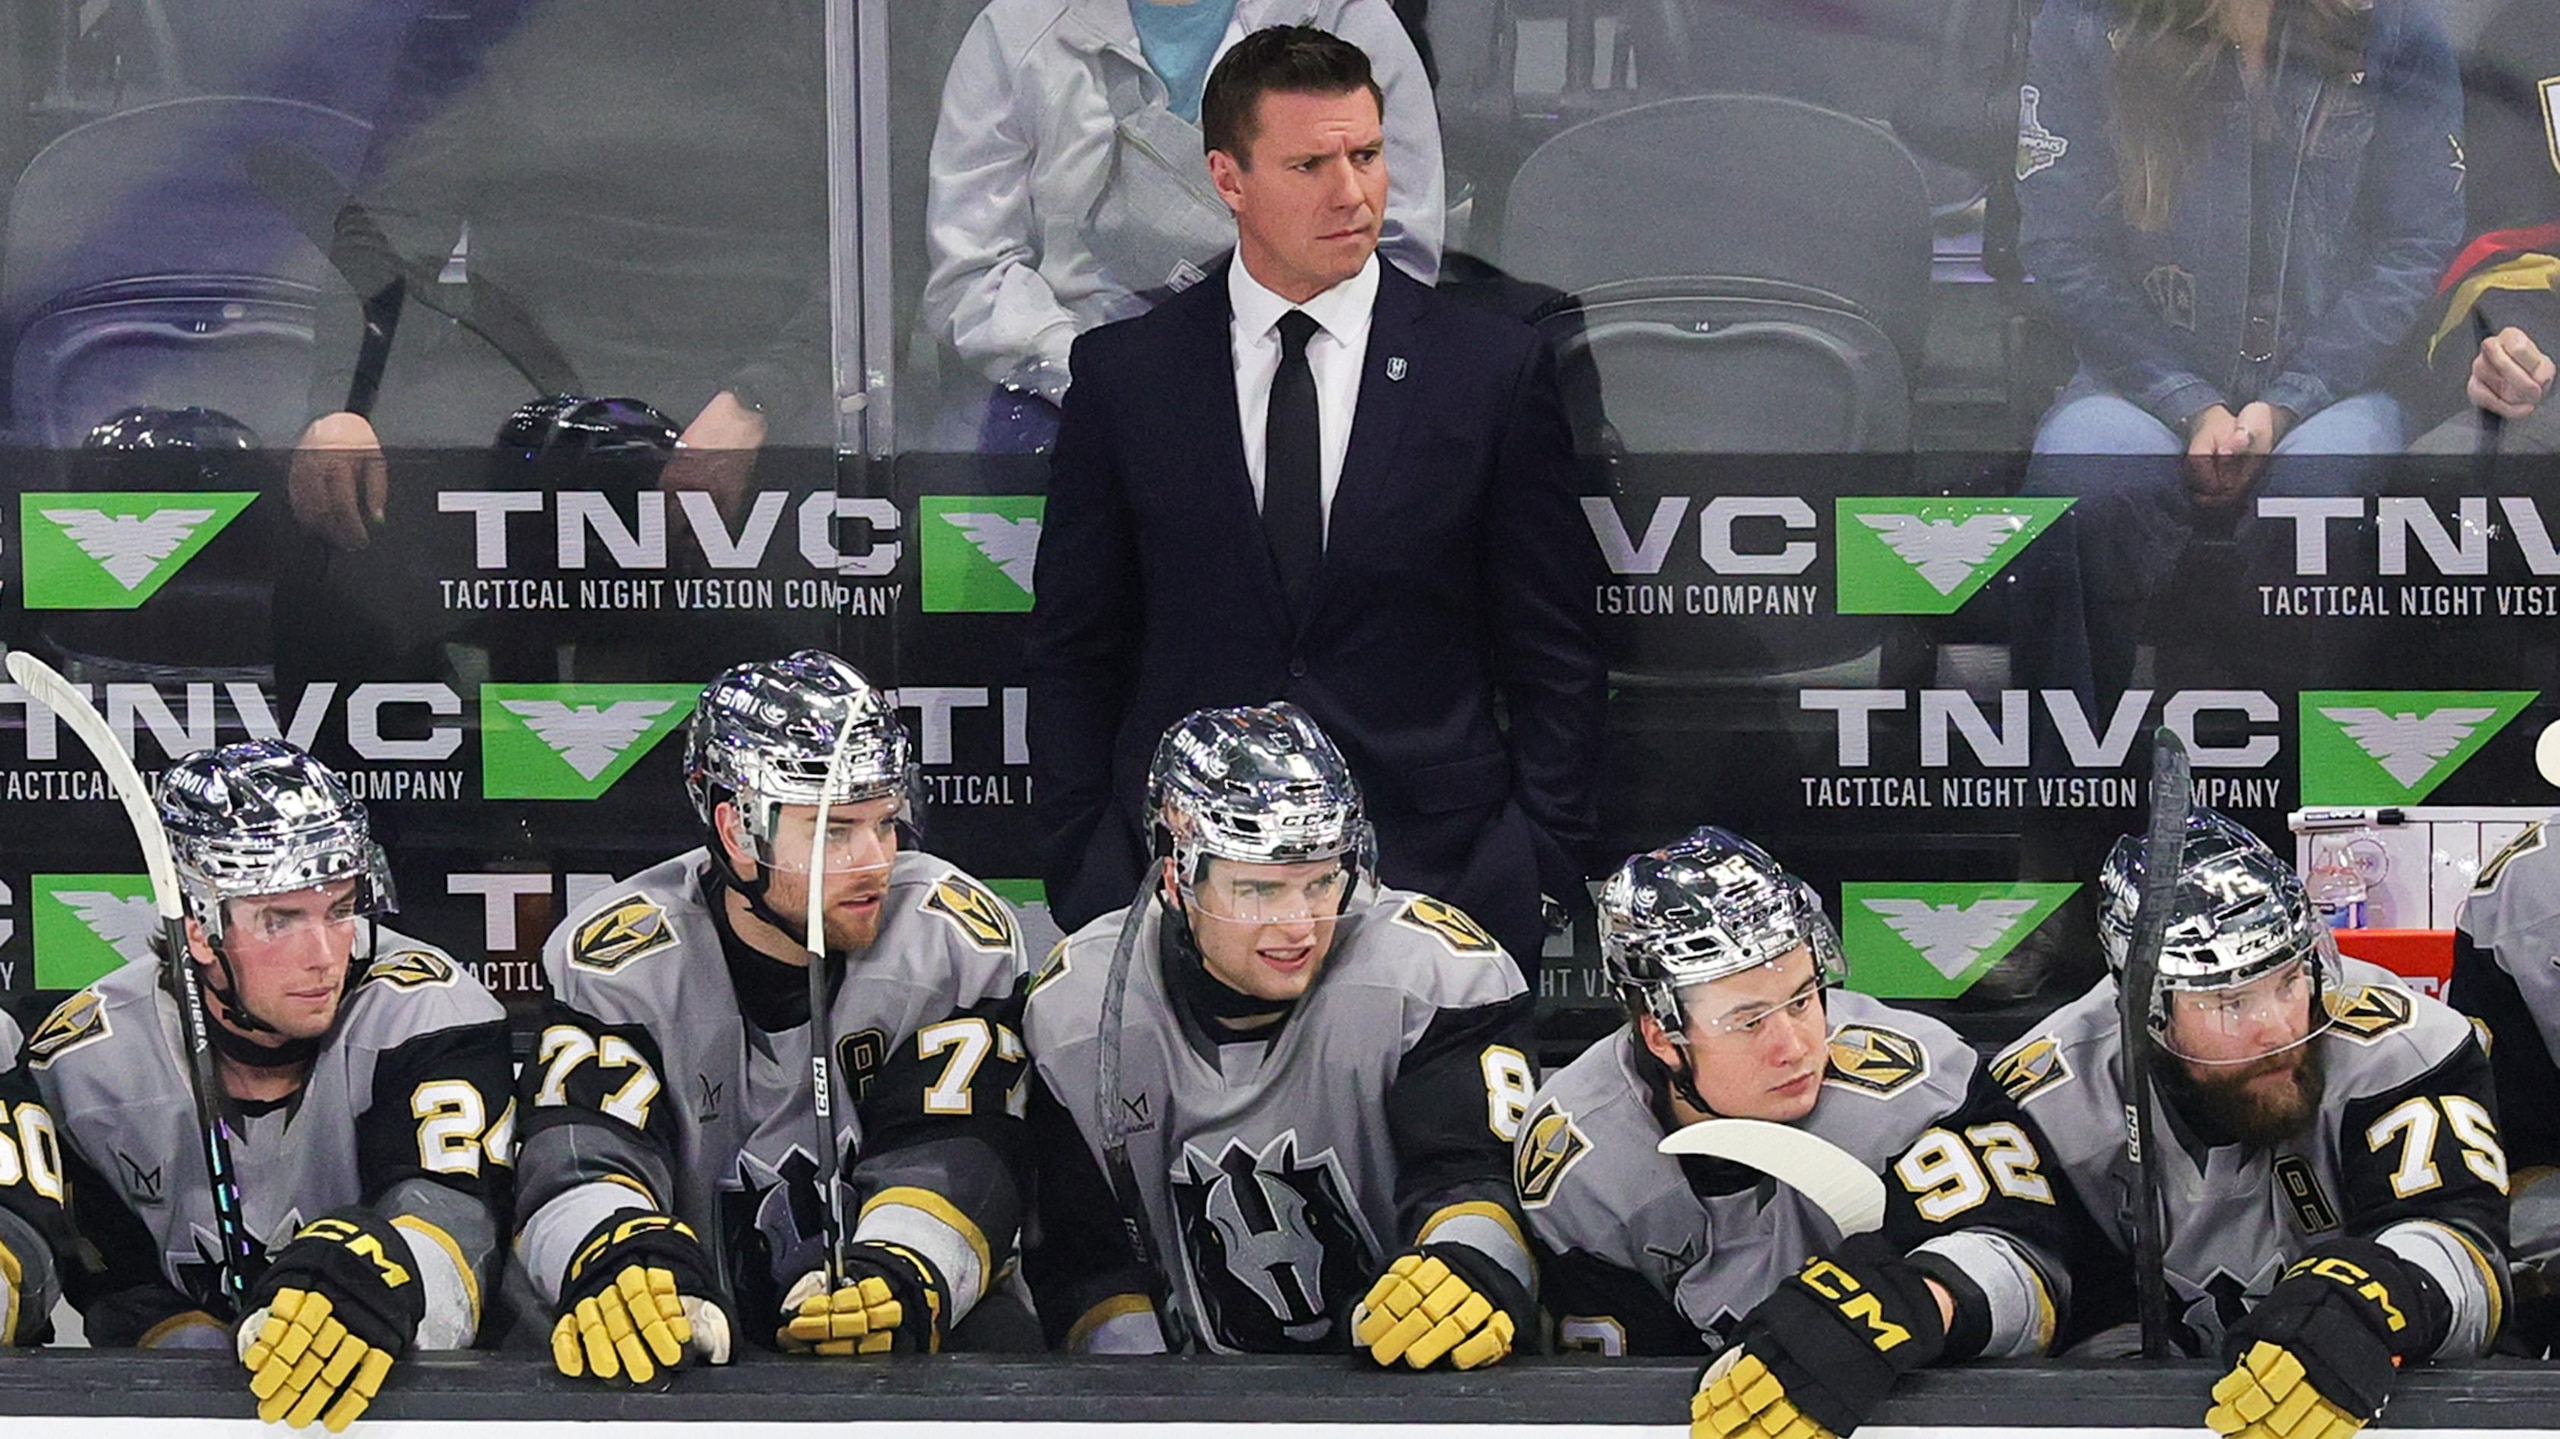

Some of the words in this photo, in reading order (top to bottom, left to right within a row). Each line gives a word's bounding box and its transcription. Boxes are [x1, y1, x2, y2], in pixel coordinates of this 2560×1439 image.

[438, 491, 901, 575] TNVC
[1580, 497, 1817, 574] VC
[2257, 497, 2560, 574] TNV
[440, 580, 569, 609] TACTICAL
[580, 580, 664, 609] NIGHT
[675, 580, 772, 609] VISION
[785, 580, 901, 616] COMPANY
[1596, 585, 1673, 614] ISION
[1686, 585, 1817, 615] COMPANY
[2258, 586, 2389, 616] TACTICAL
[2401, 586, 2486, 616] NIGHT
[2496, 586, 2558, 616] VISI
[0, 683, 463, 760] TNVC
[1800, 690, 2279, 767] TNVC
[0, 771, 121, 800] ACTICAL
[1801, 778, 1931, 807] TACTICAL
[1943, 778, 2028, 807] NIGHT
[2038, 778, 2137, 807] VISION
[534, 1024, 661, 1131] 77
[814, 1061, 828, 1113] CCM
[2126, 1106, 2140, 1160] CCM
[2365, 1095, 2510, 1199] 75
[1894, 1121, 2056, 1223] 92
[294, 1218, 411, 1289] CM
[1800, 1256, 1912, 1352] CM
